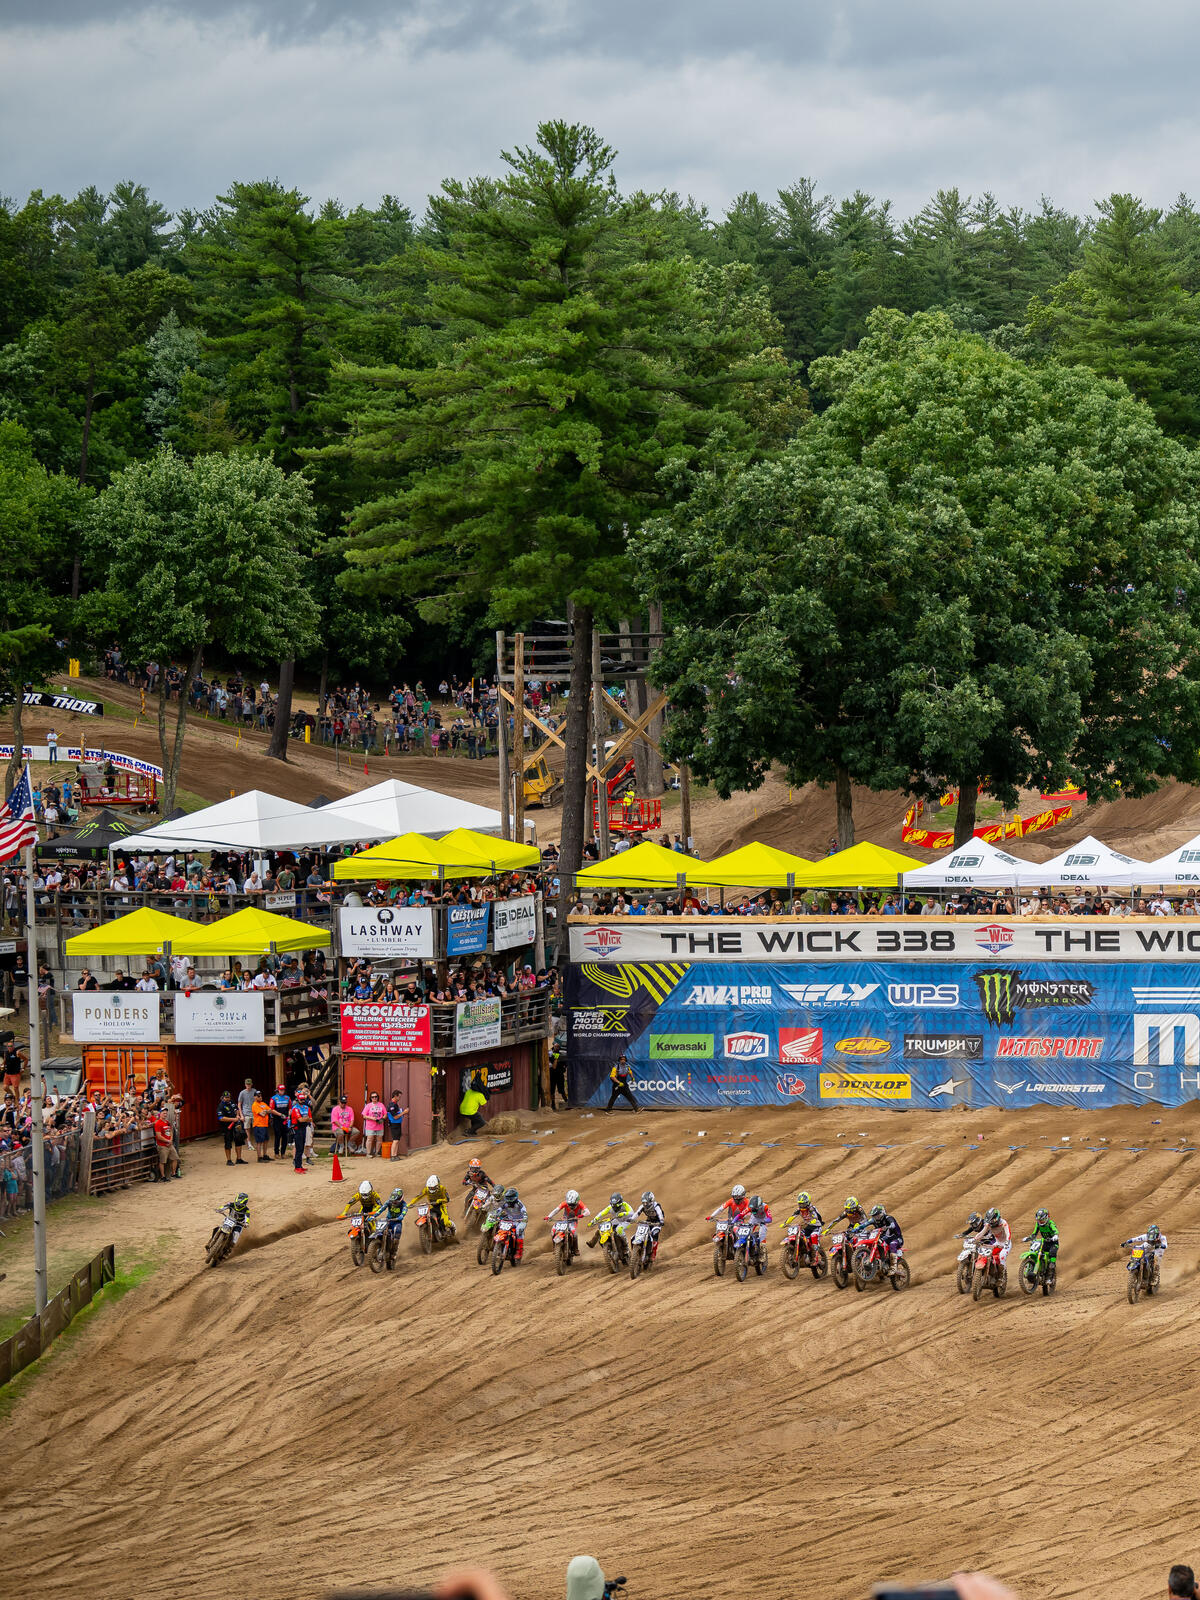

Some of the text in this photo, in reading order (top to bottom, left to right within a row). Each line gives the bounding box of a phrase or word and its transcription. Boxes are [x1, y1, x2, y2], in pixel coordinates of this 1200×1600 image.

[53, 696, 98, 714] THOR
[451, 907, 487, 923] CRESTVIEW
[508, 906, 534, 921] IDEAL
[350, 925, 424, 936] LASHWAY
[661, 931, 956, 953] THE WICK 338
[1035, 930, 1120, 952] THE
[682, 985, 739, 1006] AMA
[740, 985, 772, 998] PRO
[781, 983, 881, 1002] FLY
[888, 983, 959, 1007] WPS
[1016, 981, 1089, 996] MONSTER
[740, 997, 772, 1005] RACING
[85, 1008, 149, 1020] PONDERS
[343, 1004, 428, 1018] ASSOCIATED
[656, 1042, 707, 1052] Kawasaki
[729, 1038, 763, 1053] 100%
[906, 1040, 967, 1051] TRIUMPH
[627, 1075, 686, 1092] eacock
[706, 1074, 760, 1084] HONDA
[837, 1081, 908, 1090] DUNLOP
[1025, 1083, 1105, 1094] LANDMASTER
